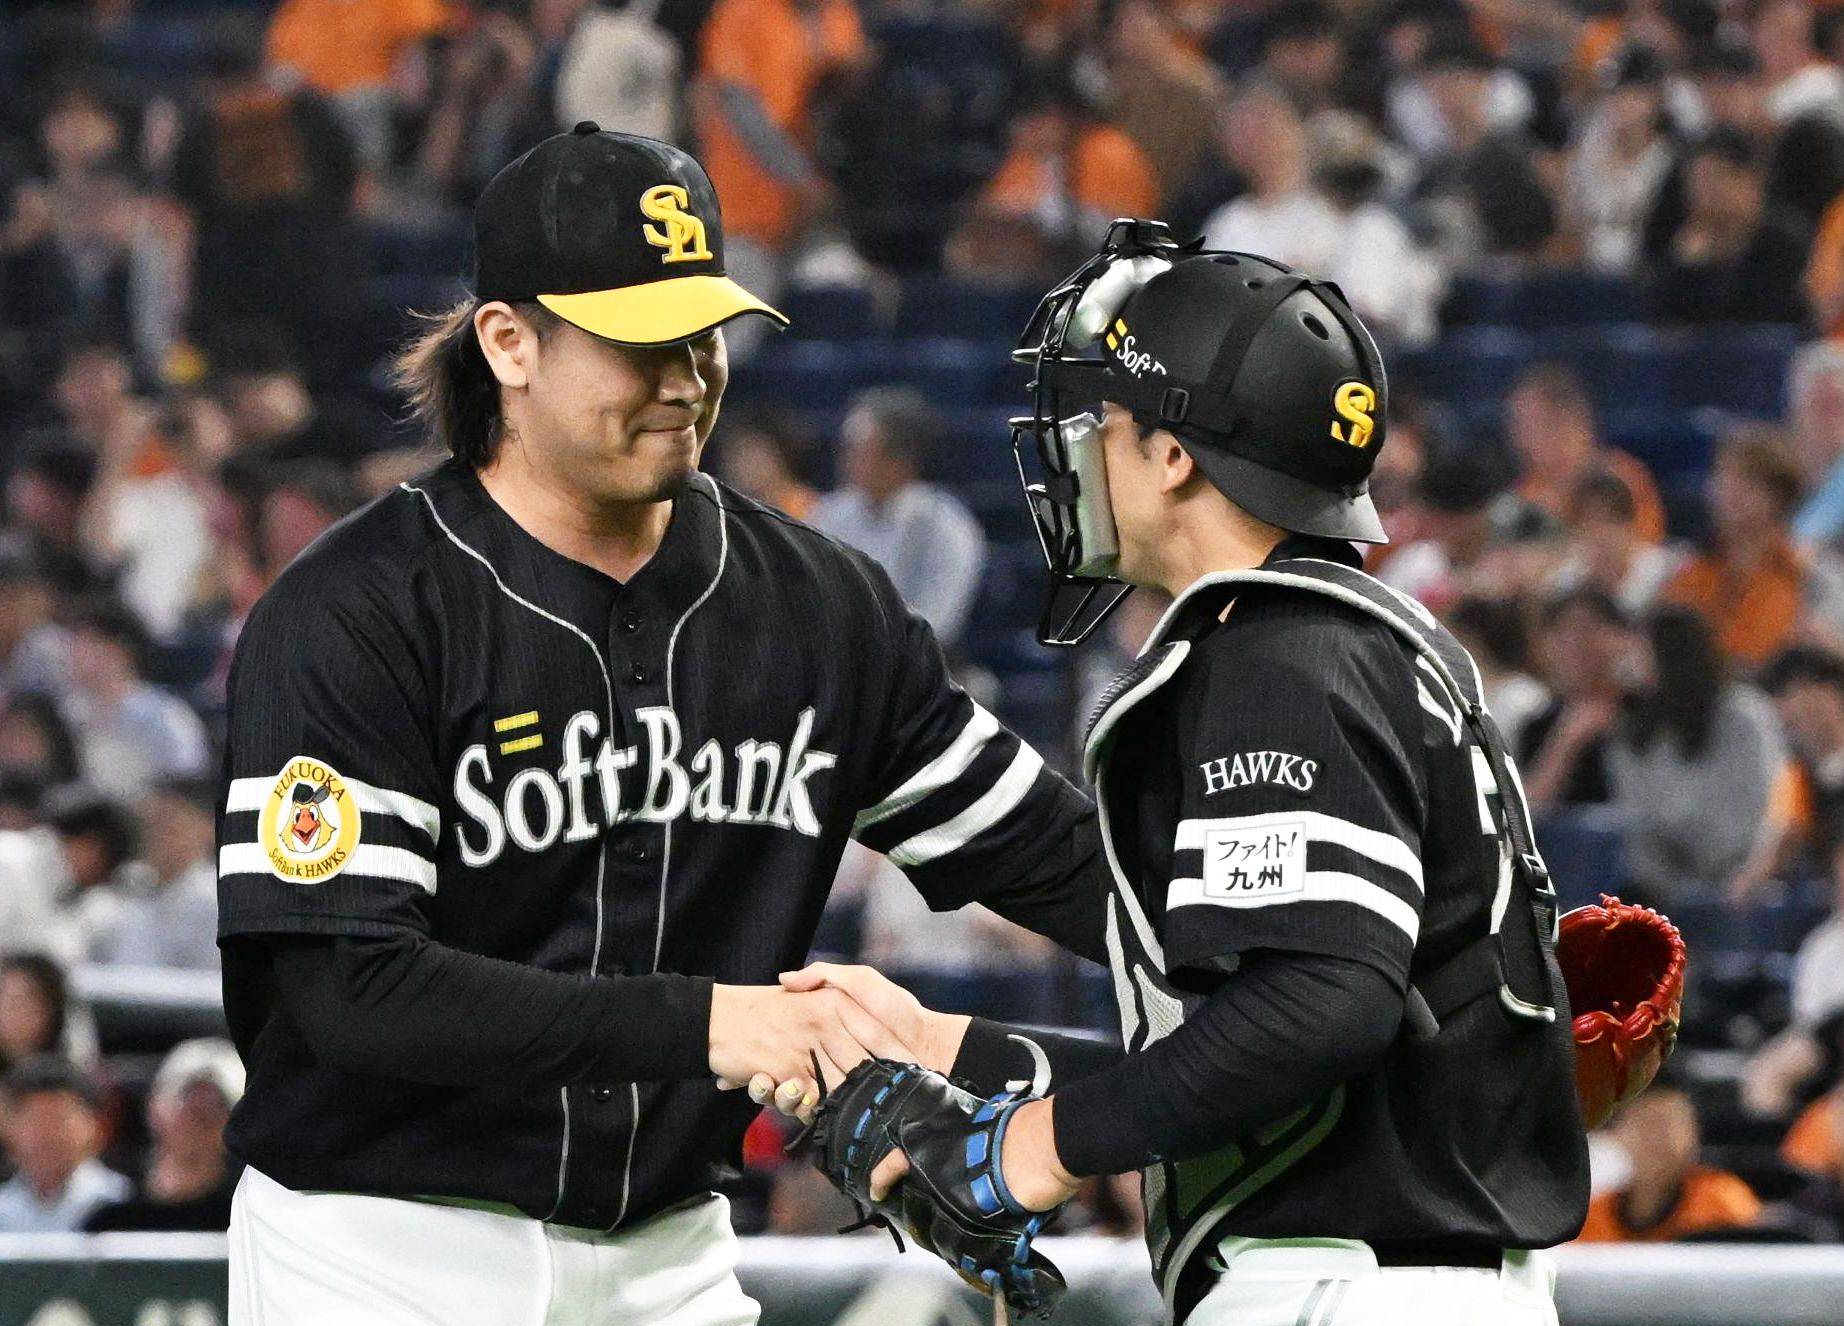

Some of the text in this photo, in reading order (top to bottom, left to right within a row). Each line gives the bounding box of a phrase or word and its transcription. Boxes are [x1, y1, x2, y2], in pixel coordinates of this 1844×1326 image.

[273, 762, 346, 802] FUKUOKA
[452, 706, 838, 868] SoftBank
[1200, 750, 1318, 795] HAWKS
[304, 847, 347, 877] HAWKS
[1217, 831, 1298, 862] ファイト!
[1225, 863, 1284, 891] 九州
